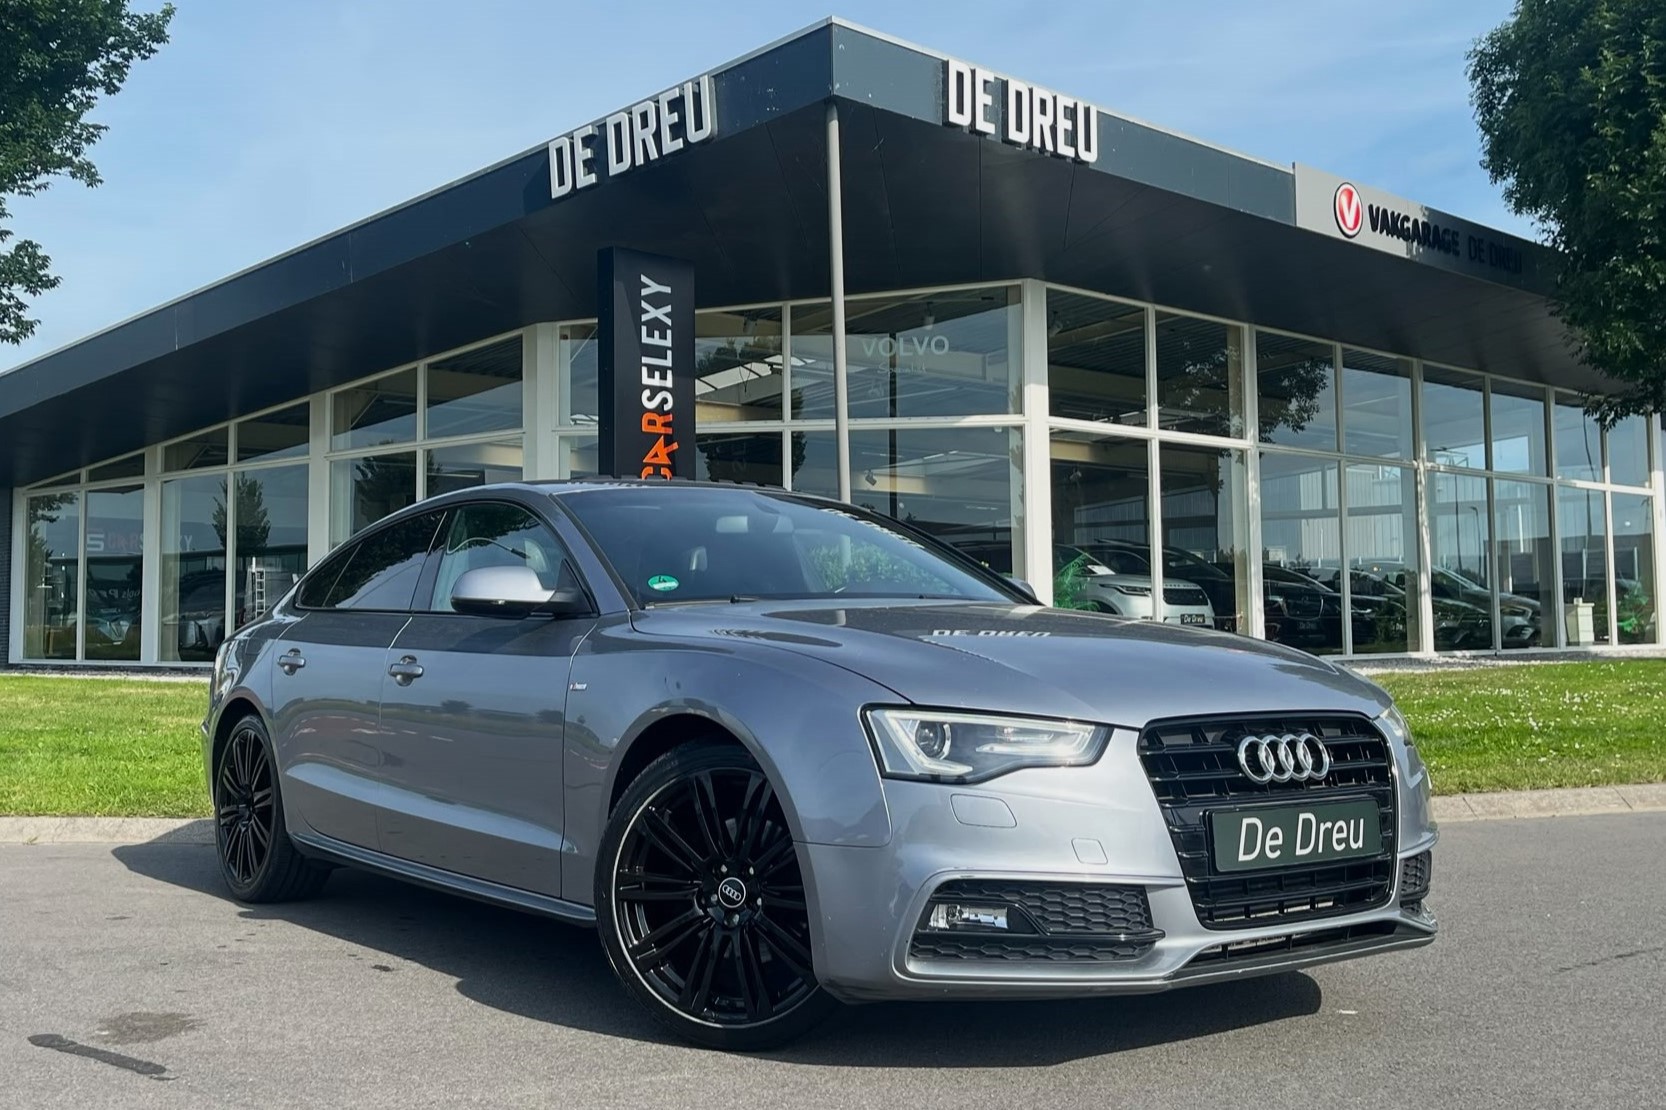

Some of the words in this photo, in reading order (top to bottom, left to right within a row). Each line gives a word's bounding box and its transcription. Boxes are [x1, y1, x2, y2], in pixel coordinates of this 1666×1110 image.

[548, 124, 597, 199] DE
[605, 74, 713, 177] DREU
[948, 59, 996, 135] DE
[1007, 79, 1098, 163] DREU
[1368, 203, 1460, 257] VAKGARAGE
[1468, 234, 1485, 264] DE
[861, 334, 950, 358] VOLVO
[1238, 817, 1283, 862] De
[1295, 812, 1364, 856] Dreu
